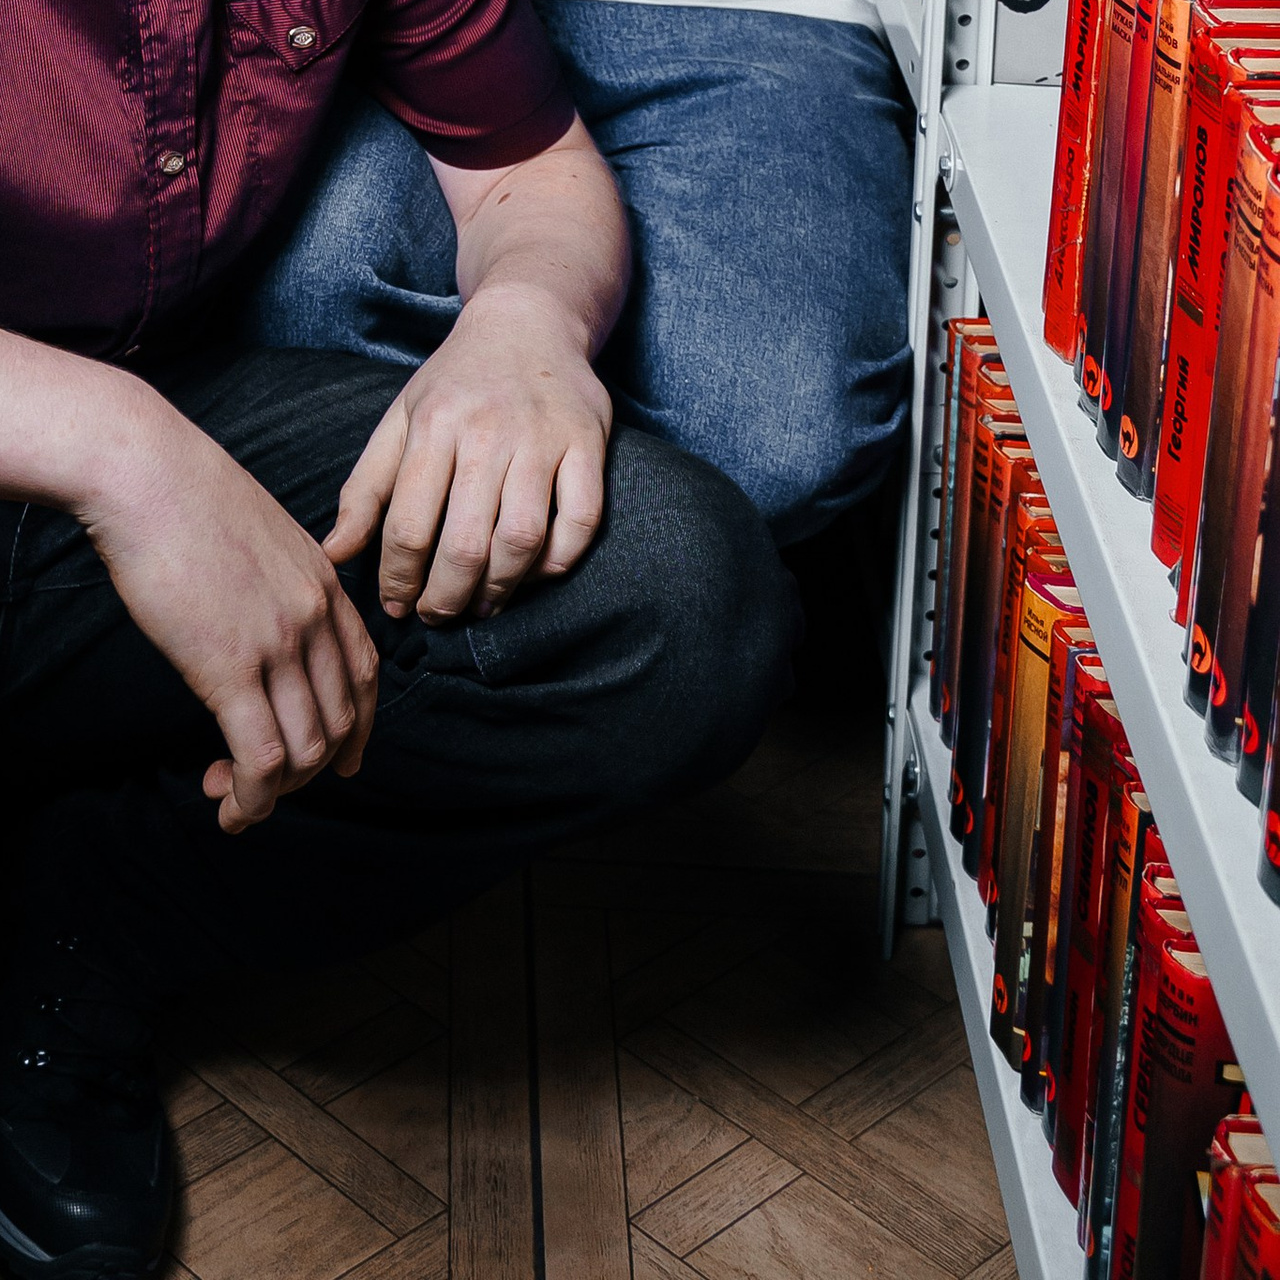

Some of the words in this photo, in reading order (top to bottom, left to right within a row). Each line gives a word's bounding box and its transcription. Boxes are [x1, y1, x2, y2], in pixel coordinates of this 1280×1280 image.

[1167, 352, 1190, 464] Георгий
[1187, 125, 1209, 283] МИРОНОВ
[1027, 605, 1046, 629] Илья
[1078, 778, 1100, 923] СЕМЕНОВ
[1133, 1006, 1156, 1134] СЕРБИН
